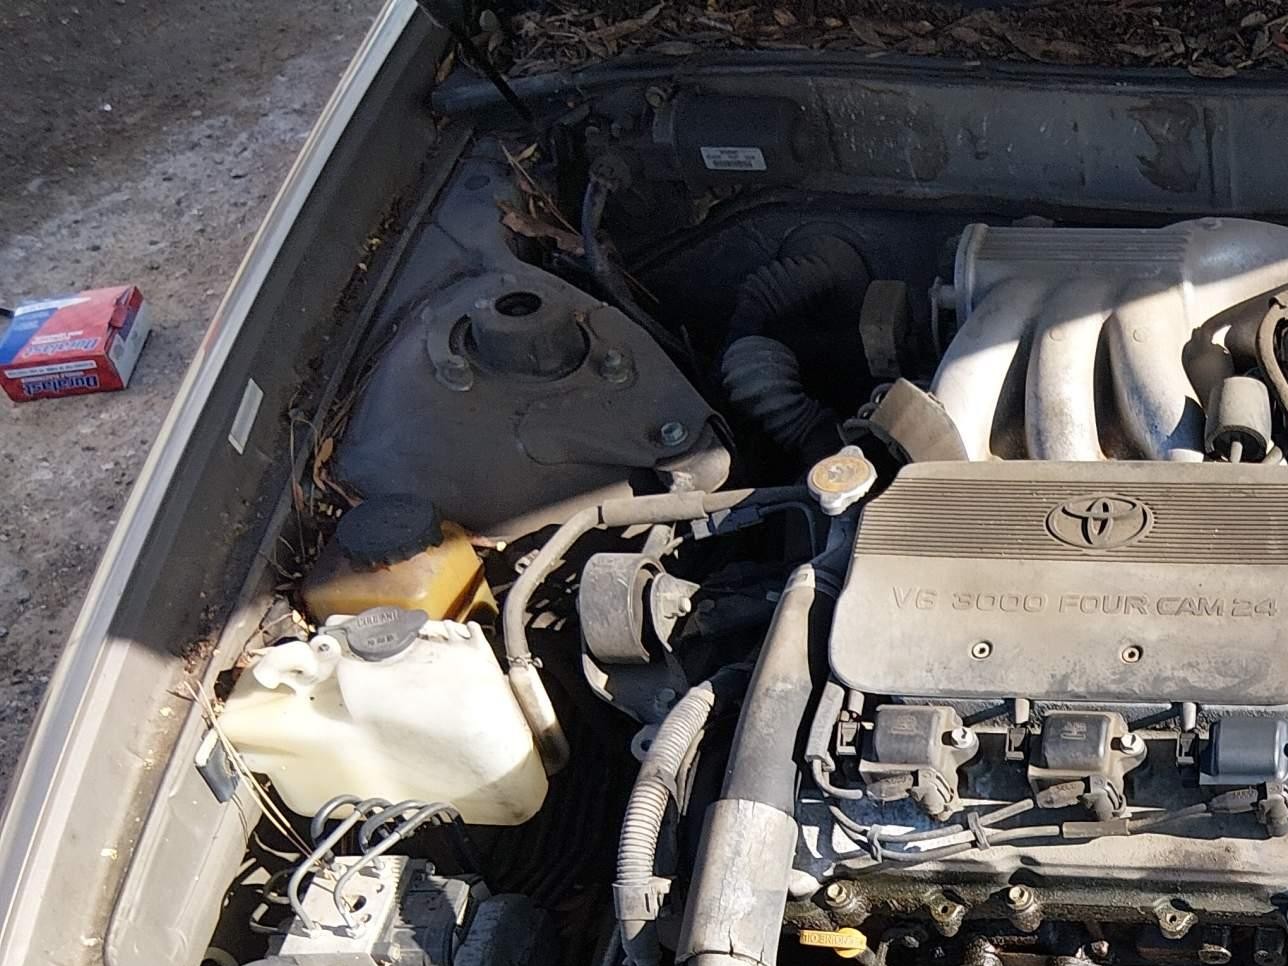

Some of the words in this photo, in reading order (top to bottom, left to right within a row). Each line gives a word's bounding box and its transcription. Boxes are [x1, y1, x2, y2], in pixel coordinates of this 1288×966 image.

[22, 375, 99, 397] Duralast
[892, 586, 937, 609] V6
[951, 592, 1047, 612] 3000
[1058, 593, 1150, 615] FOUR
[1156, 596, 1224, 616] CAM
[1231, 599, 1279, 617] 24
[801, 932, 819, 942] OIL
